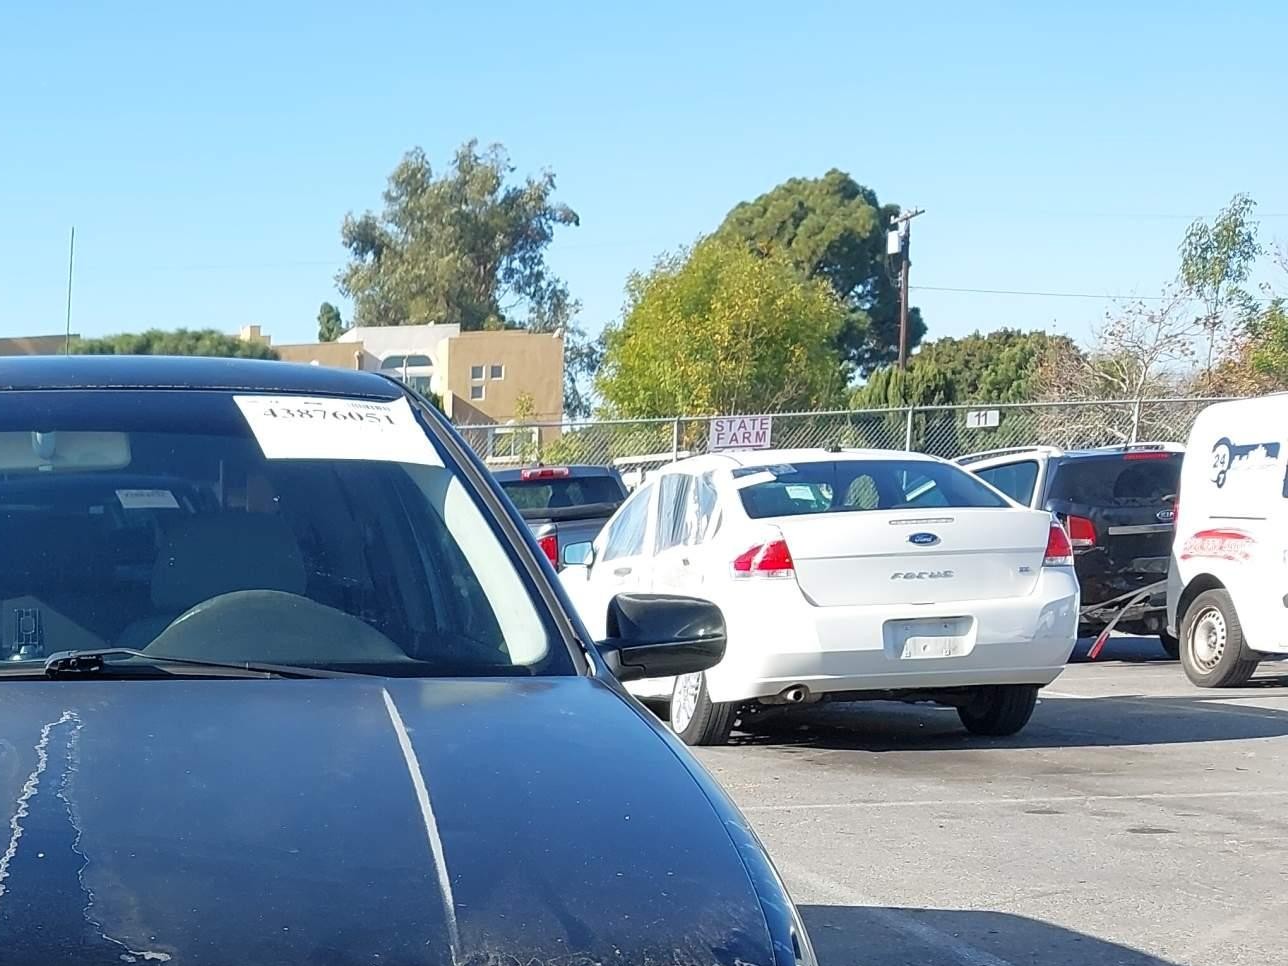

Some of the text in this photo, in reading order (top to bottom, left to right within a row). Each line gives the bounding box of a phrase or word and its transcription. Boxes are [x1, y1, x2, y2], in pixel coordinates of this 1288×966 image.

[715, 418, 769, 432] STATE
[974, 411, 988, 426] 11
[716, 431, 767, 445] FARM
[890, 571, 954, 580] FOCUS
